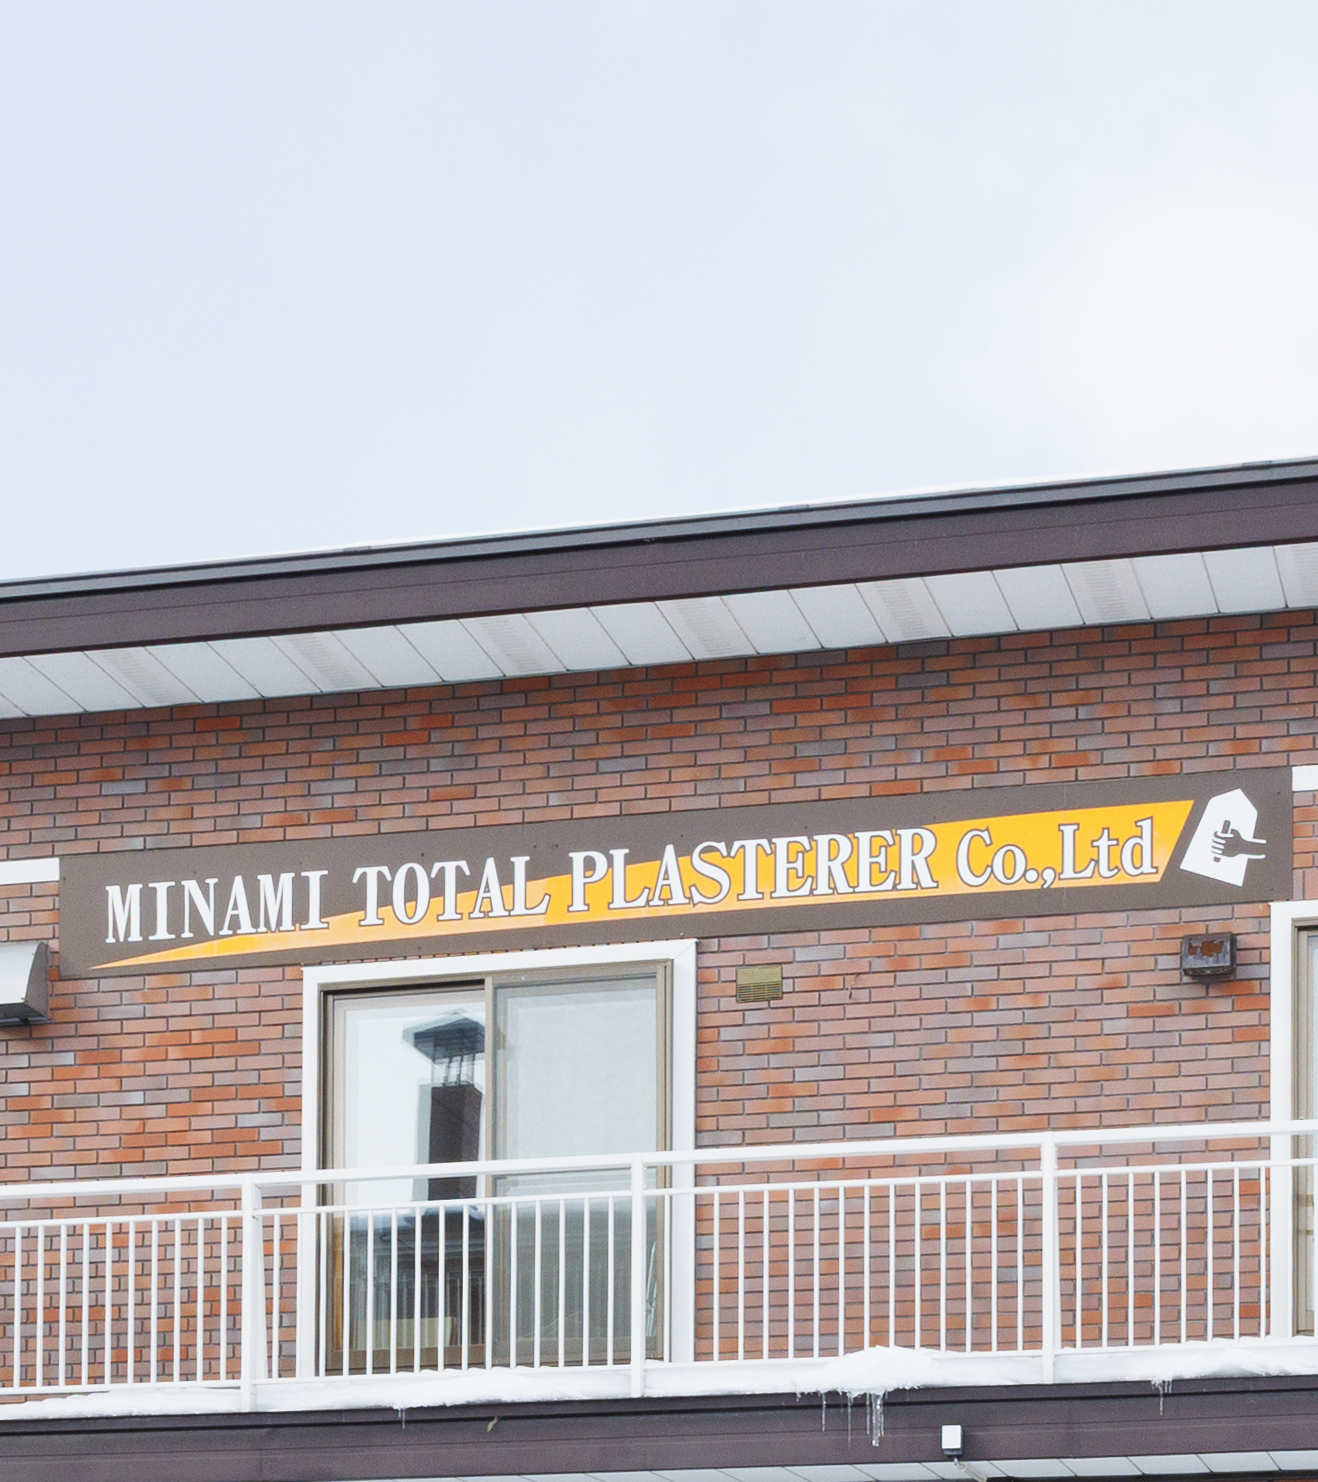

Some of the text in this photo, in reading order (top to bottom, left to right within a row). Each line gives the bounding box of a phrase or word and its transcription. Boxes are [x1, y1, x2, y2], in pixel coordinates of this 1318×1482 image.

[105, 816, 1159, 944] MINAMI TOTAL PLASTERER Co.,Ltd
